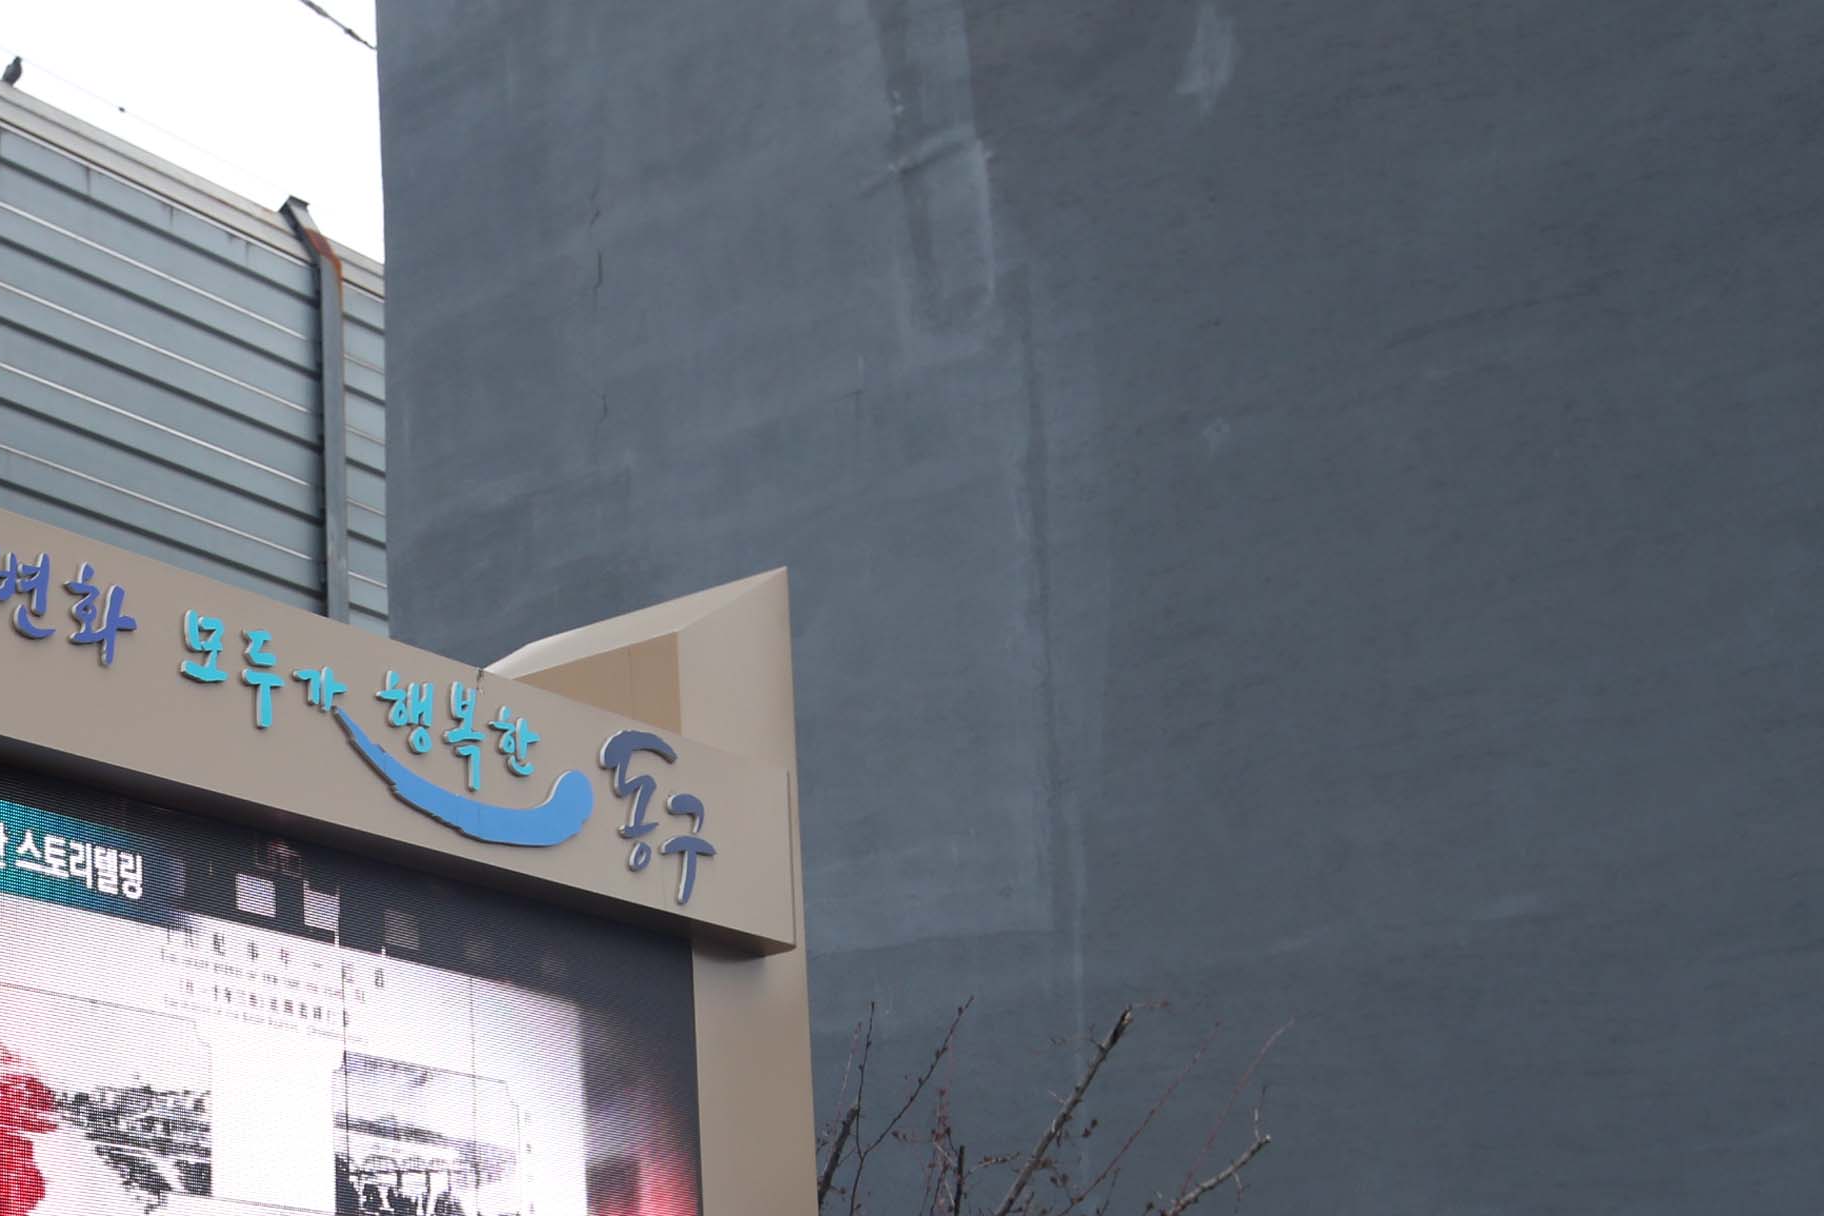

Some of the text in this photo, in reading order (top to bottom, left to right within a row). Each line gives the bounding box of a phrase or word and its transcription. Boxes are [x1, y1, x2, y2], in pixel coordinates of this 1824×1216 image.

[179, 608, 348, 729] 모두가
[376, 670, 540, 791] 행복한
[599, 728, 717, 905] 동구
[15, 829, 145, 901] 스토리텔링
